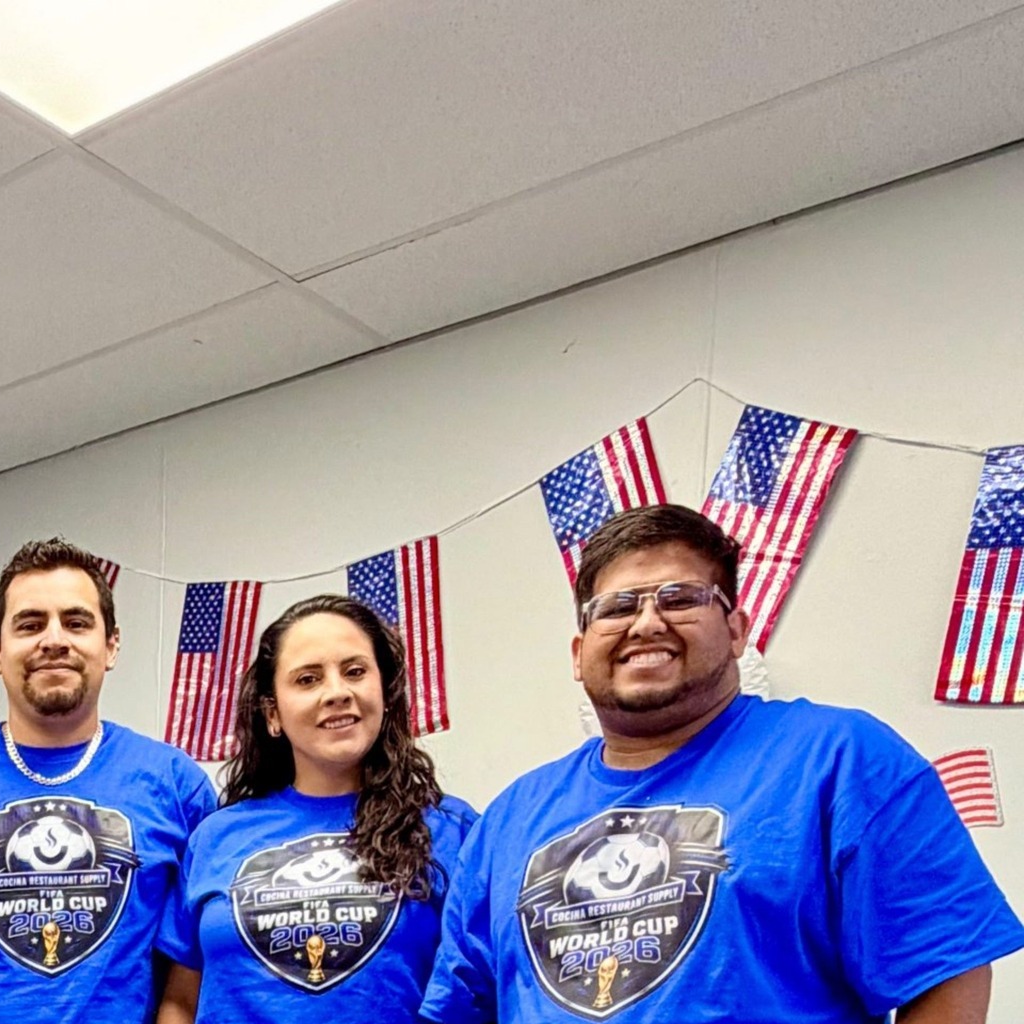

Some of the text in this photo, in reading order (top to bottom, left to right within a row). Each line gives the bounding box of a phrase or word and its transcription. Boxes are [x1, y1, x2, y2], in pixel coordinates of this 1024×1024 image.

[69, 896, 106, 912] CUP
[303, 901, 329, 909] FIFA
[551, 886, 678, 922] COCINA RESTAURANT SUPPLY
[8, 911, 95, 938] 2026
[257, 906, 377, 931] WORLD CUP
[600, 917, 628, 931] FIFA
[270, 922, 363, 954] 2026
[549, 915, 678, 958] WORLD CUP
[559, 936, 661, 983] 2026
